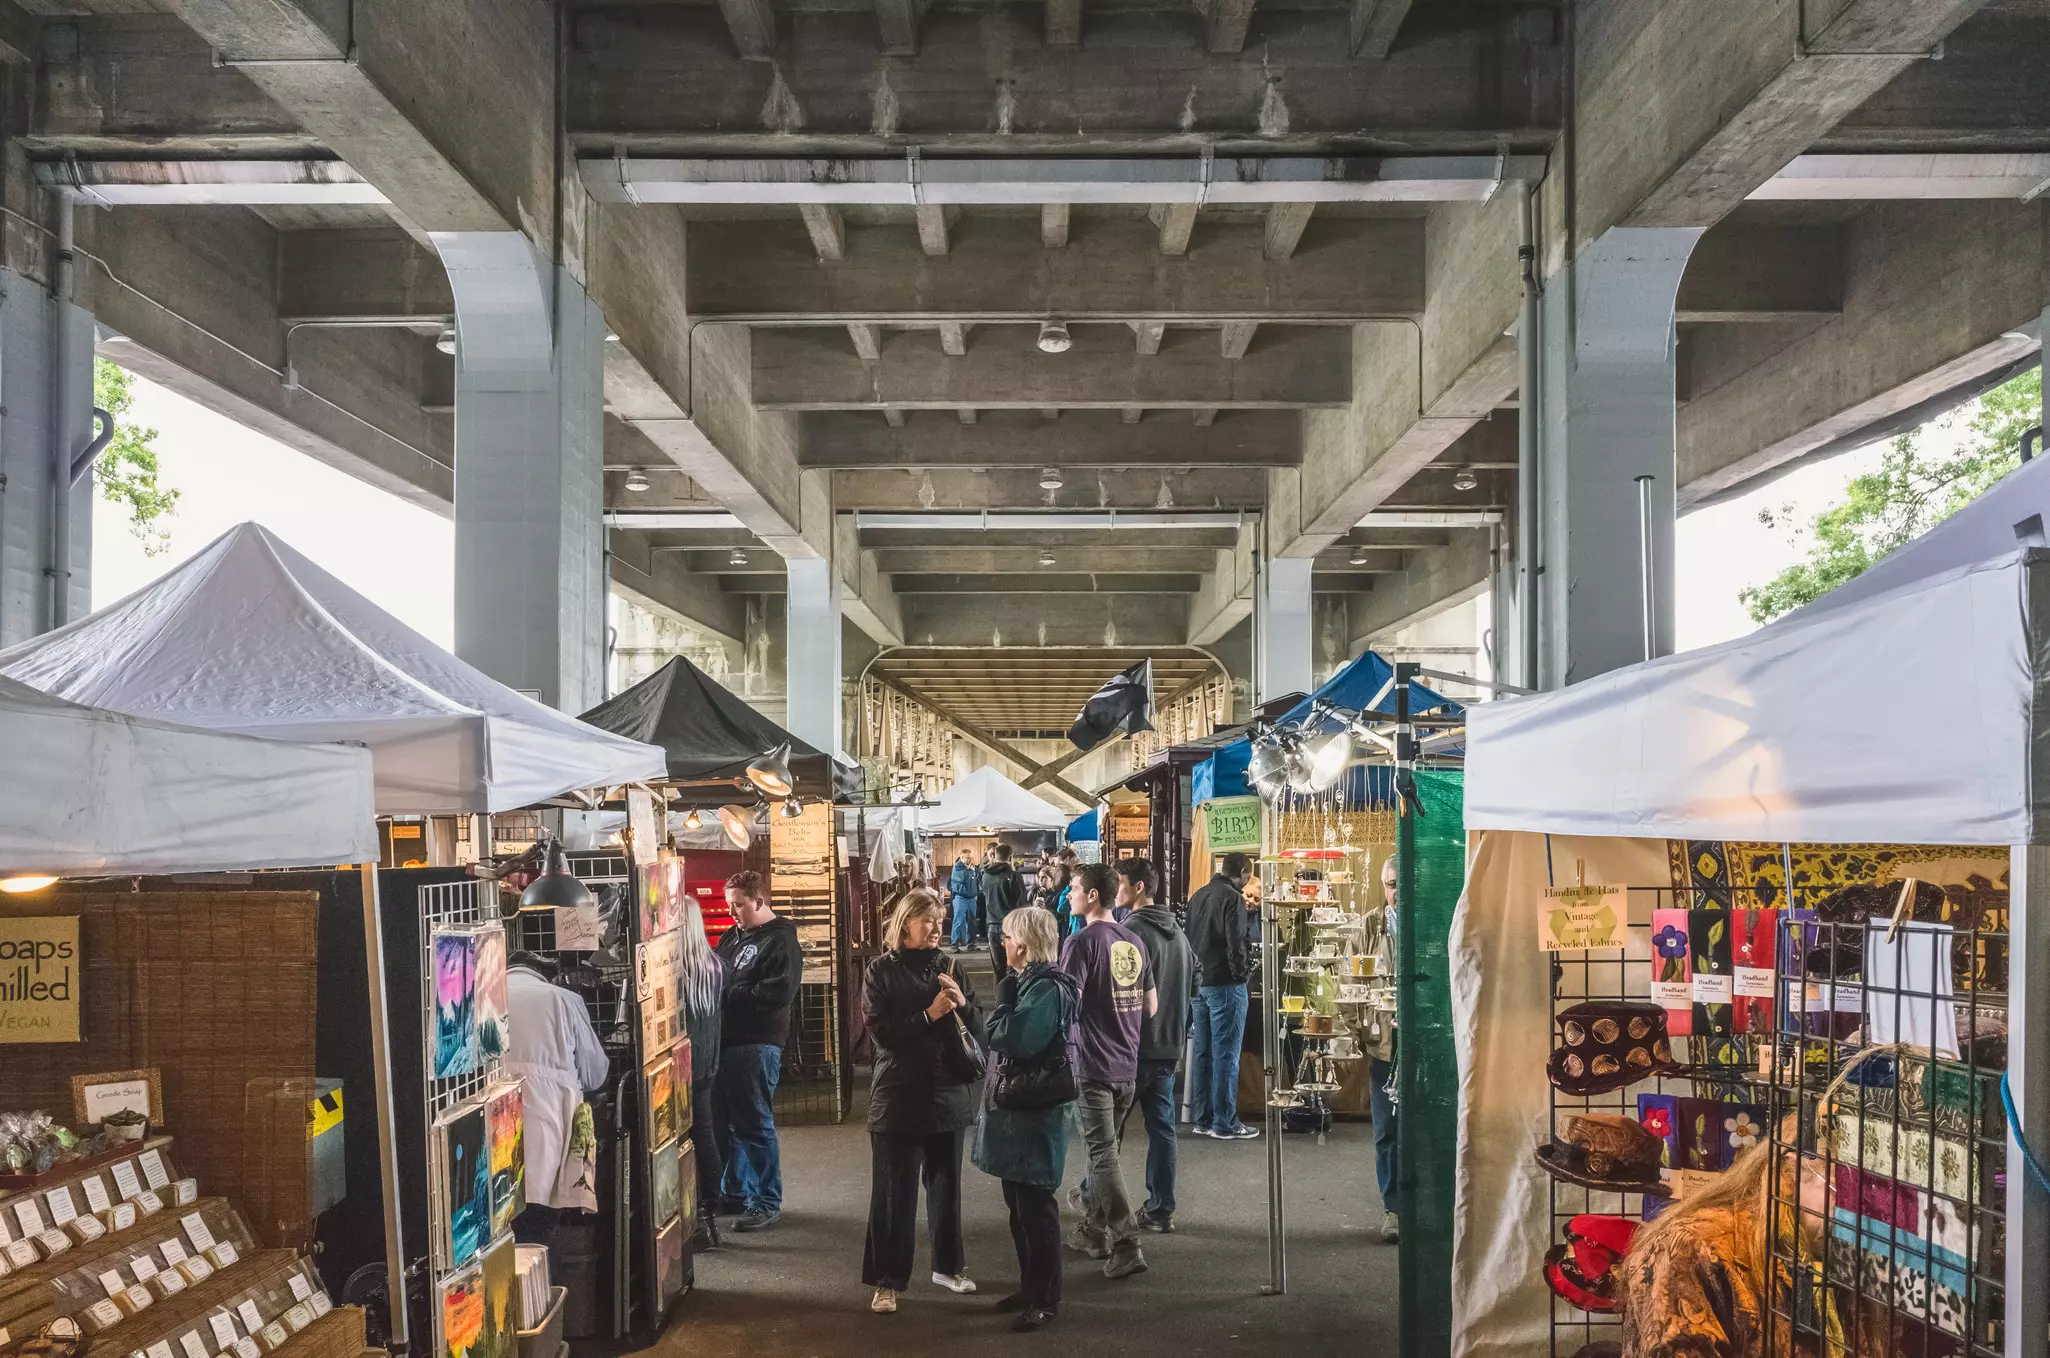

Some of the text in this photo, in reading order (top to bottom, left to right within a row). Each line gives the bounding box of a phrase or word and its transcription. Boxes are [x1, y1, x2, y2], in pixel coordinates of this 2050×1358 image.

[1211, 816, 1256, 835] BIRD
[1544, 885, 1620, 898] Handmde Hats
[1564, 911, 1599, 921] Vintage
[1574, 925, 1590, 933] and
[1590, 937, 1623, 947] Fabrics
[1742, 974, 1769, 982] Headband
